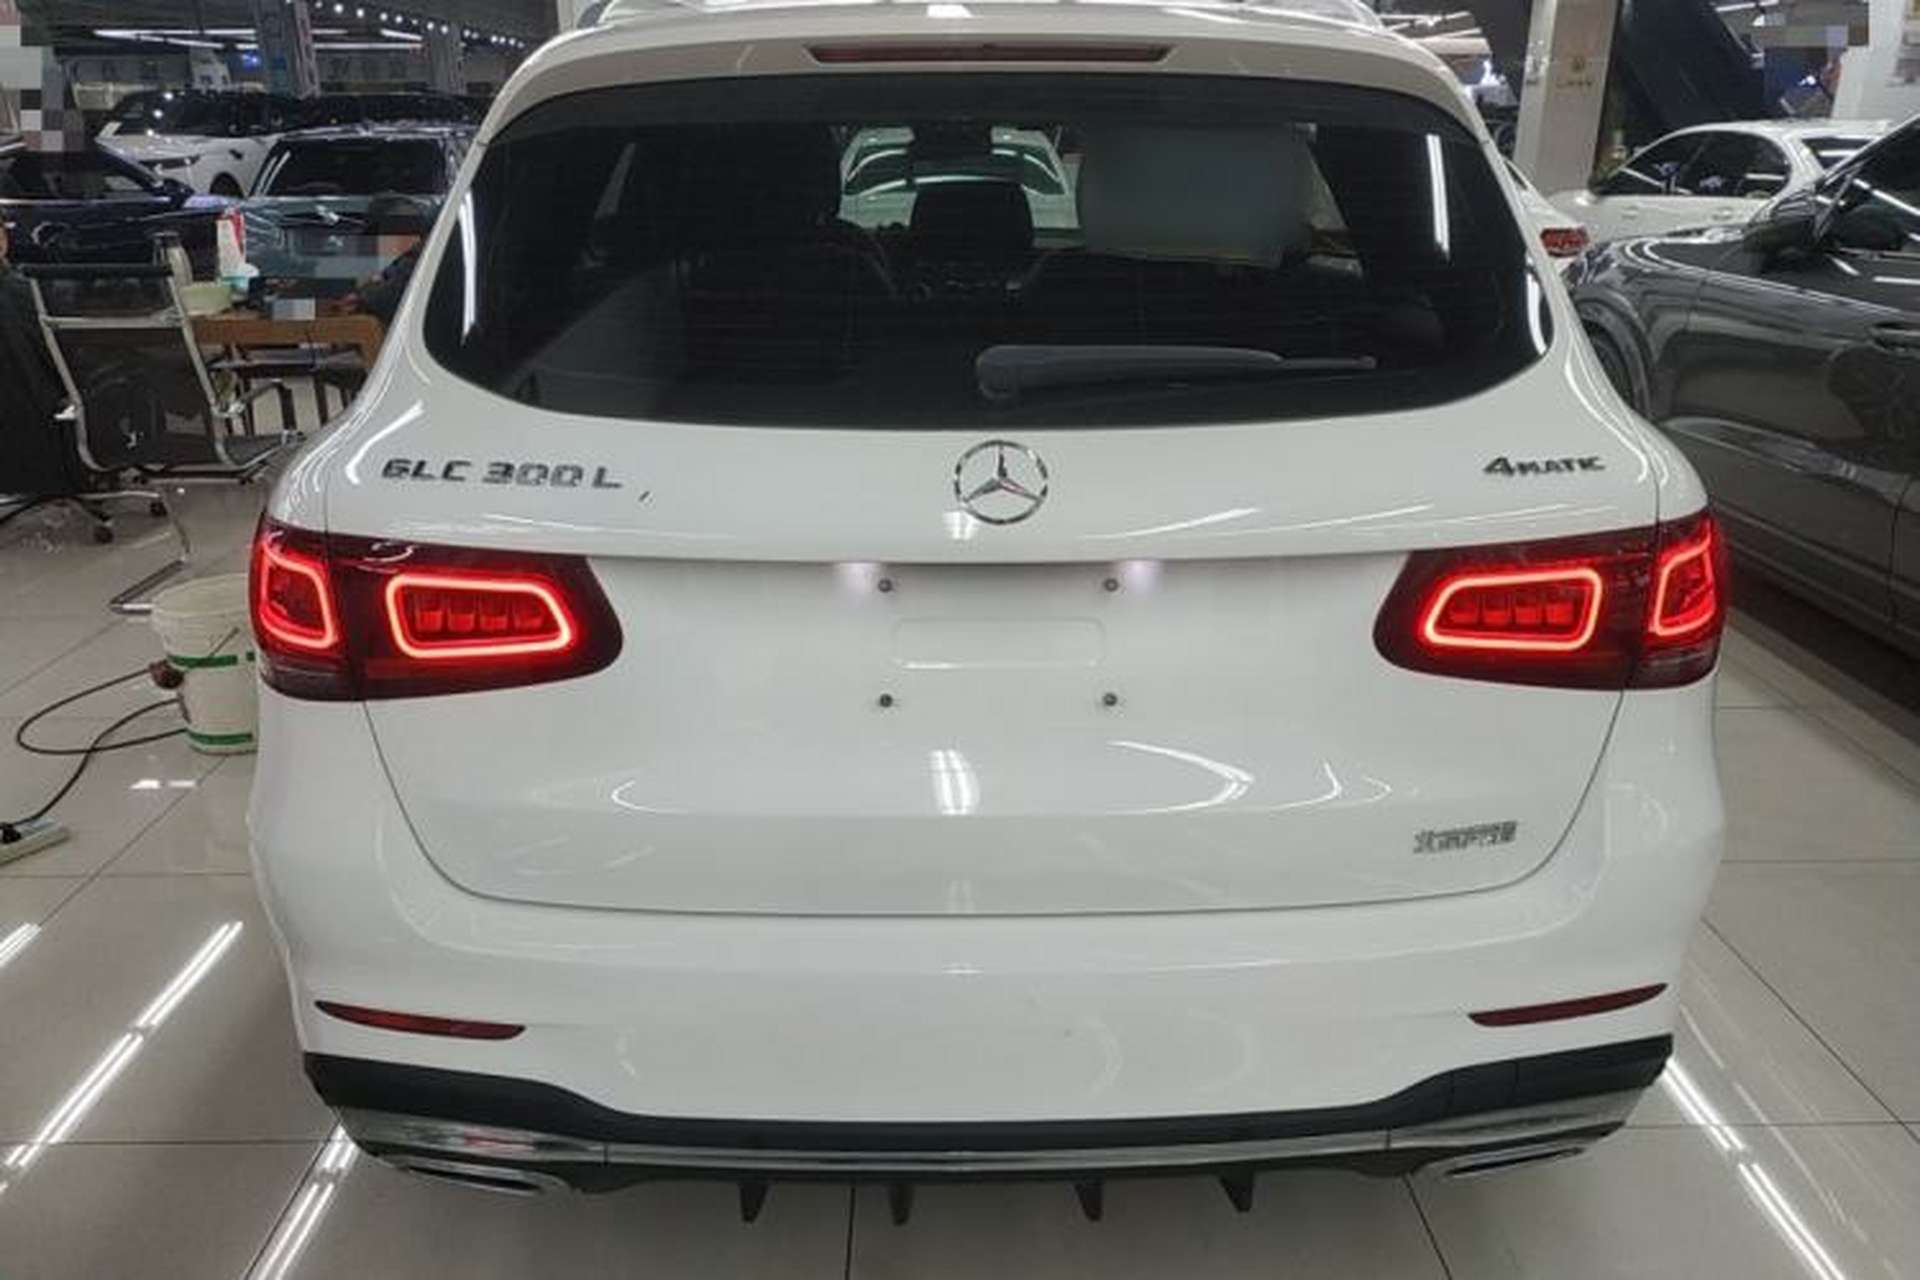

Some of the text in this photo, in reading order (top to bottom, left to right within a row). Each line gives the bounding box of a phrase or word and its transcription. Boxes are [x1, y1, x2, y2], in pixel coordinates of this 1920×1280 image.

[382, 459, 623, 489] GLC 300 L
[1484, 456, 1606, 477] 4MATIC
